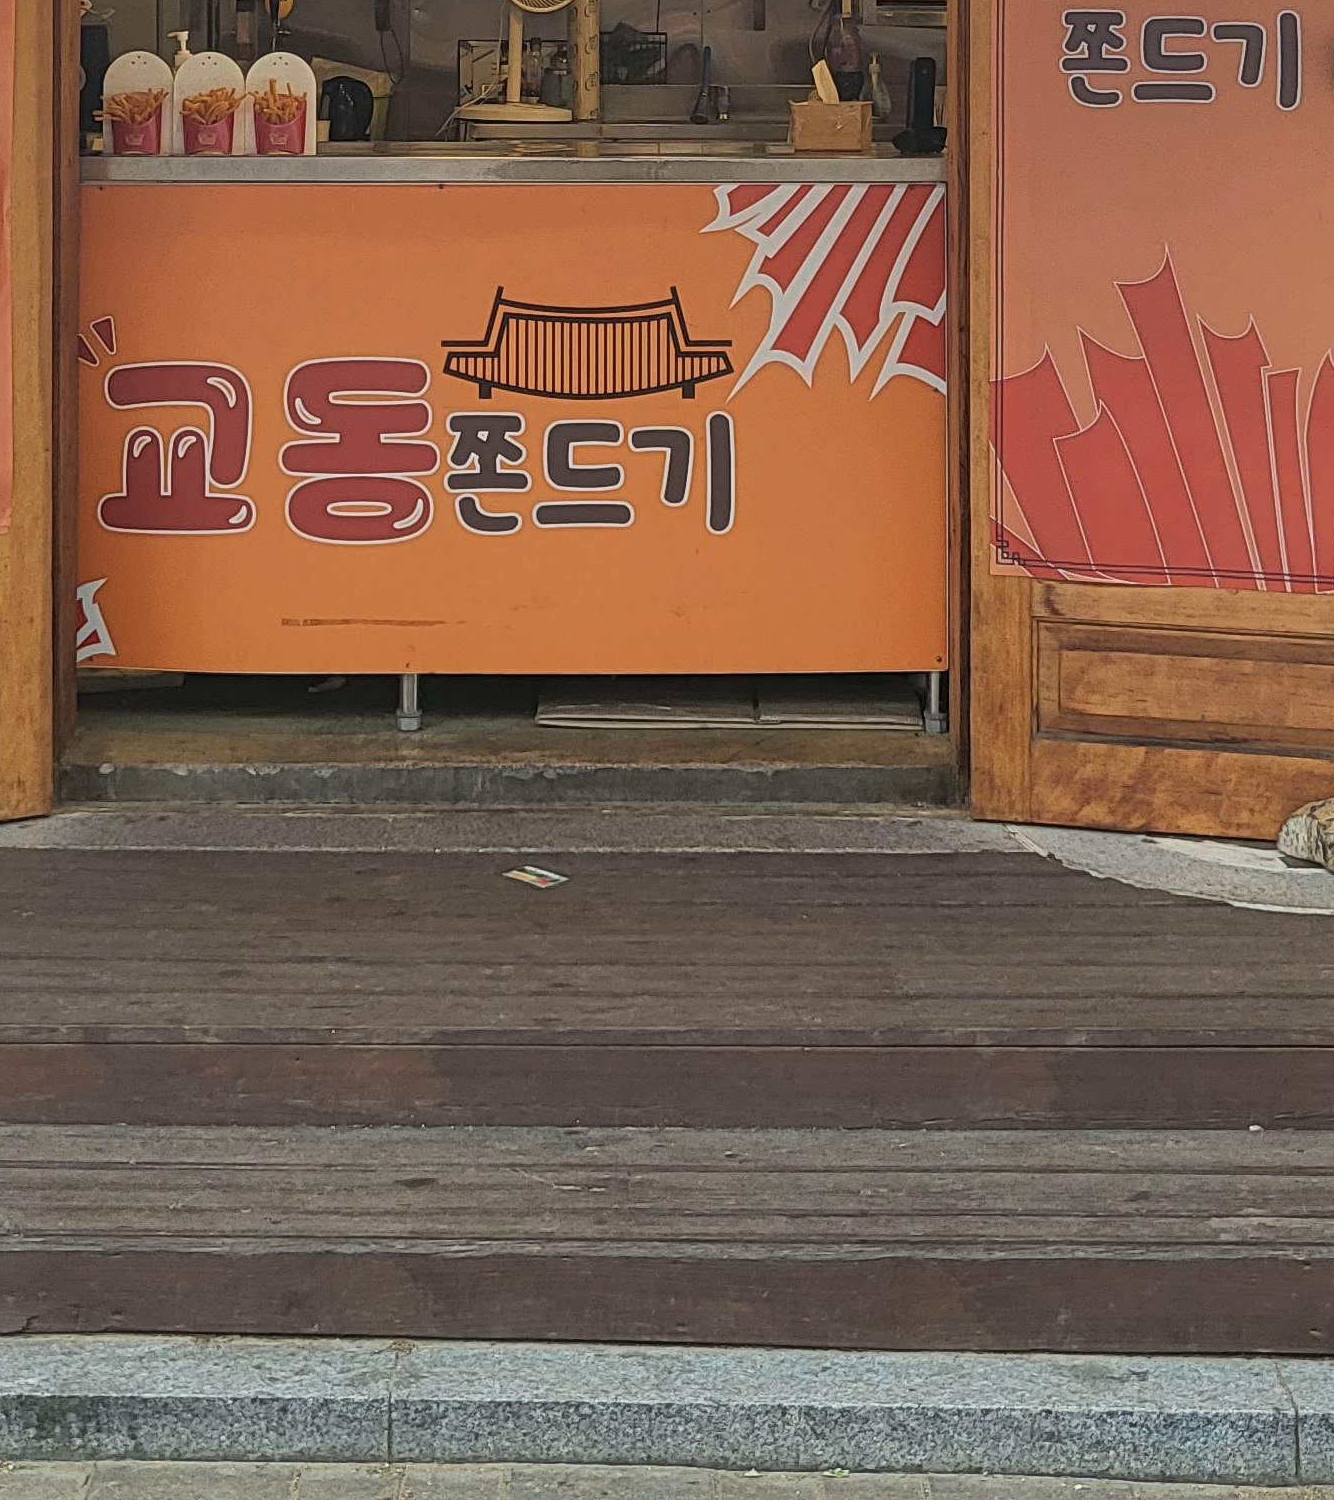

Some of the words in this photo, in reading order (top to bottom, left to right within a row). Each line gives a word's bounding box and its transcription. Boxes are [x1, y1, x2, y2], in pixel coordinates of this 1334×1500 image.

[1059, 8, 1302, 111] 쫀드기
[96, 357, 440, 545] 교동
[443, 410, 735, 536] 쫀드기
